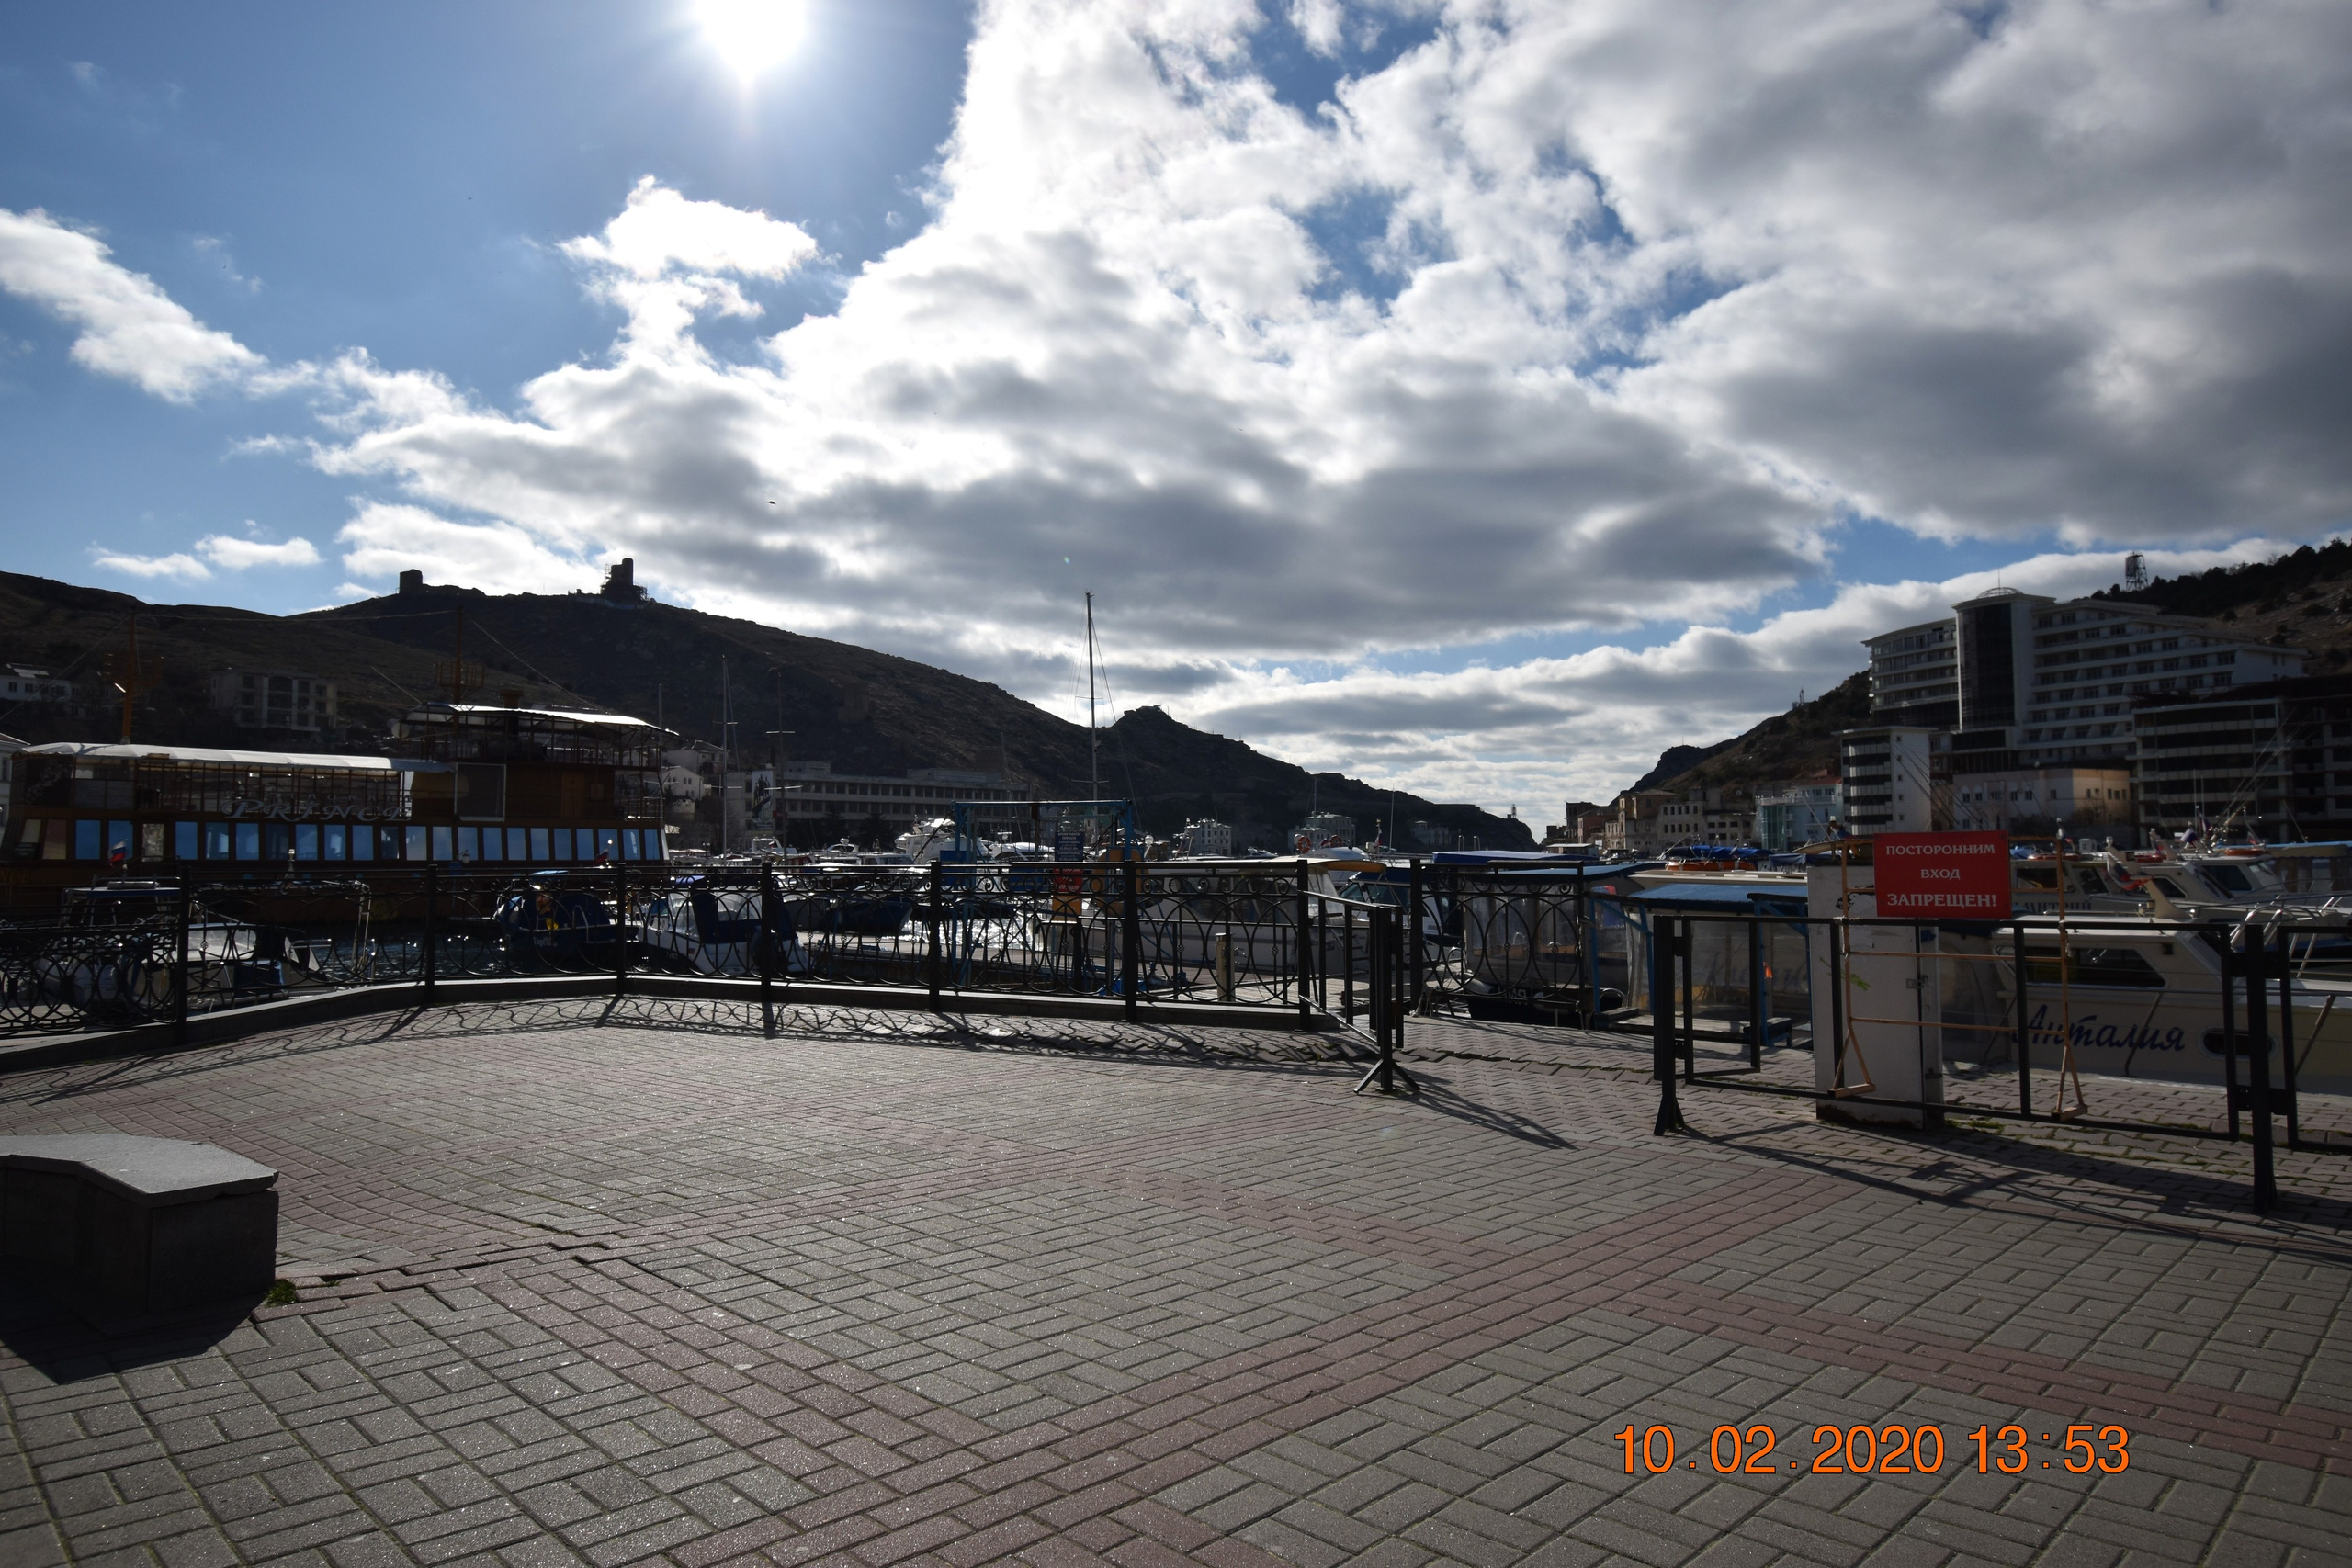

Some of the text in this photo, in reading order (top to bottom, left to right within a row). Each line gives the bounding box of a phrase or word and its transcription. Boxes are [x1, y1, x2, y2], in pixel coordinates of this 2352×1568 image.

[220, 799, 413, 822] PRINCE
[1885, 844, 1996, 855] ПОСТОРОННИМ
[1920, 868, 1961, 881] ВХОД
[1887, 893, 1997, 909] ЗАПРЕЩЕН!
[2012, 901, 2093, 913] МИТРИЙ
[2011, 1003, 2186, 1052] Анталия
